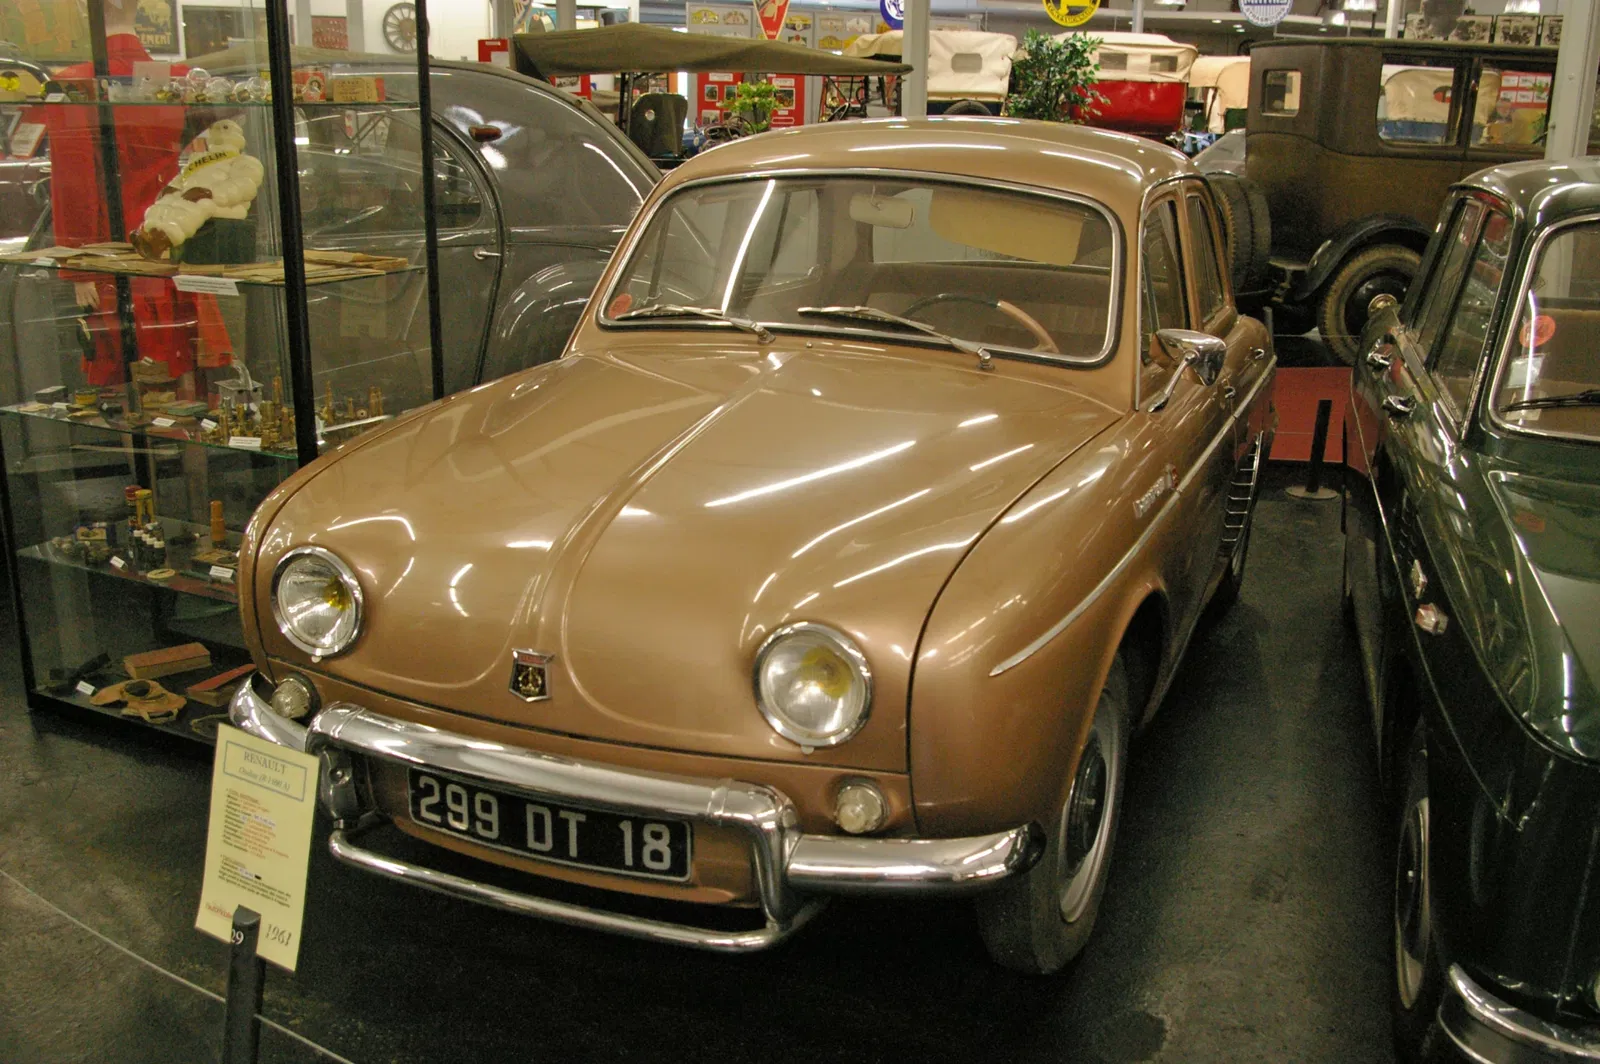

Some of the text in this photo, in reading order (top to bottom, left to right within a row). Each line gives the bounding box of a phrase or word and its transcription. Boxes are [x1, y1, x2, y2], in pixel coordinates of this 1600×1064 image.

[244, 751, 286, 774] RENAULT
[419, 775, 672, 871] 299 DT 18
[265, 924, 292, 946] 1961
